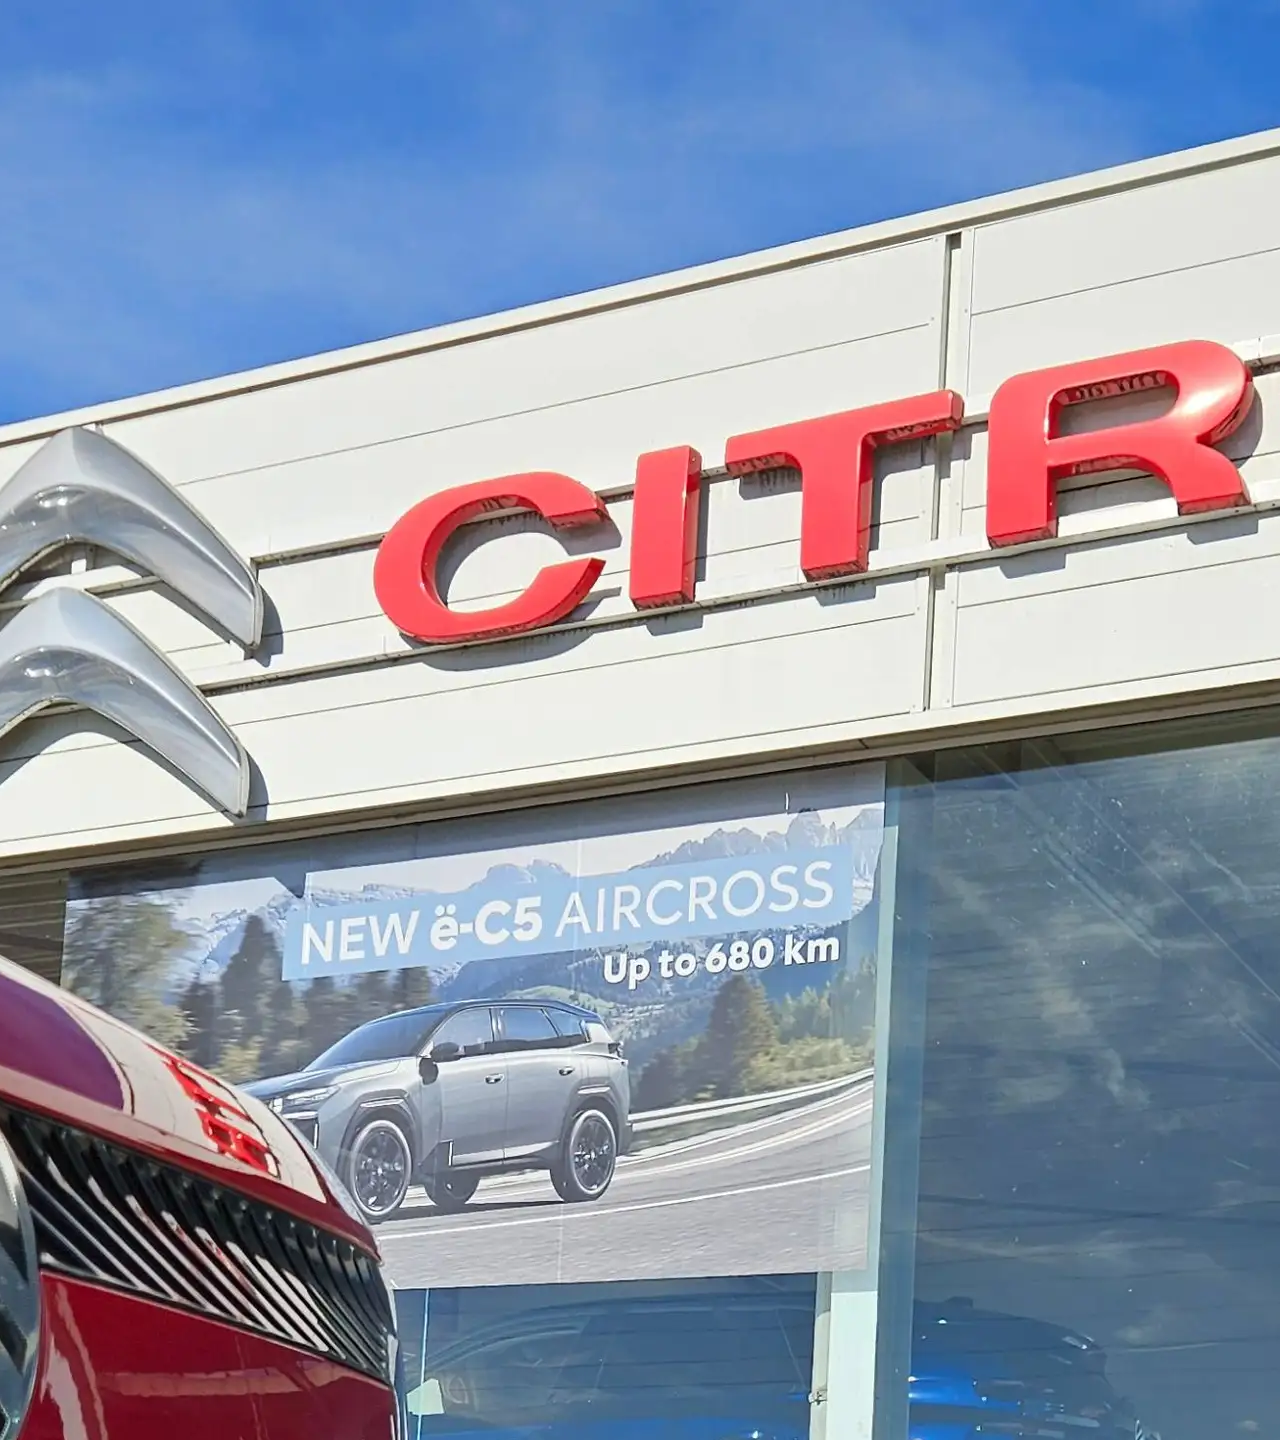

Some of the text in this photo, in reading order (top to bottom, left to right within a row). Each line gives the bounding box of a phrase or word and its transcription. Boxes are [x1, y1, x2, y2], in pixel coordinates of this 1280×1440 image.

[301, 860, 834, 964] NEW ë-C5 AIRCROSS
[604, 933, 839, 990] Up to 680 km
